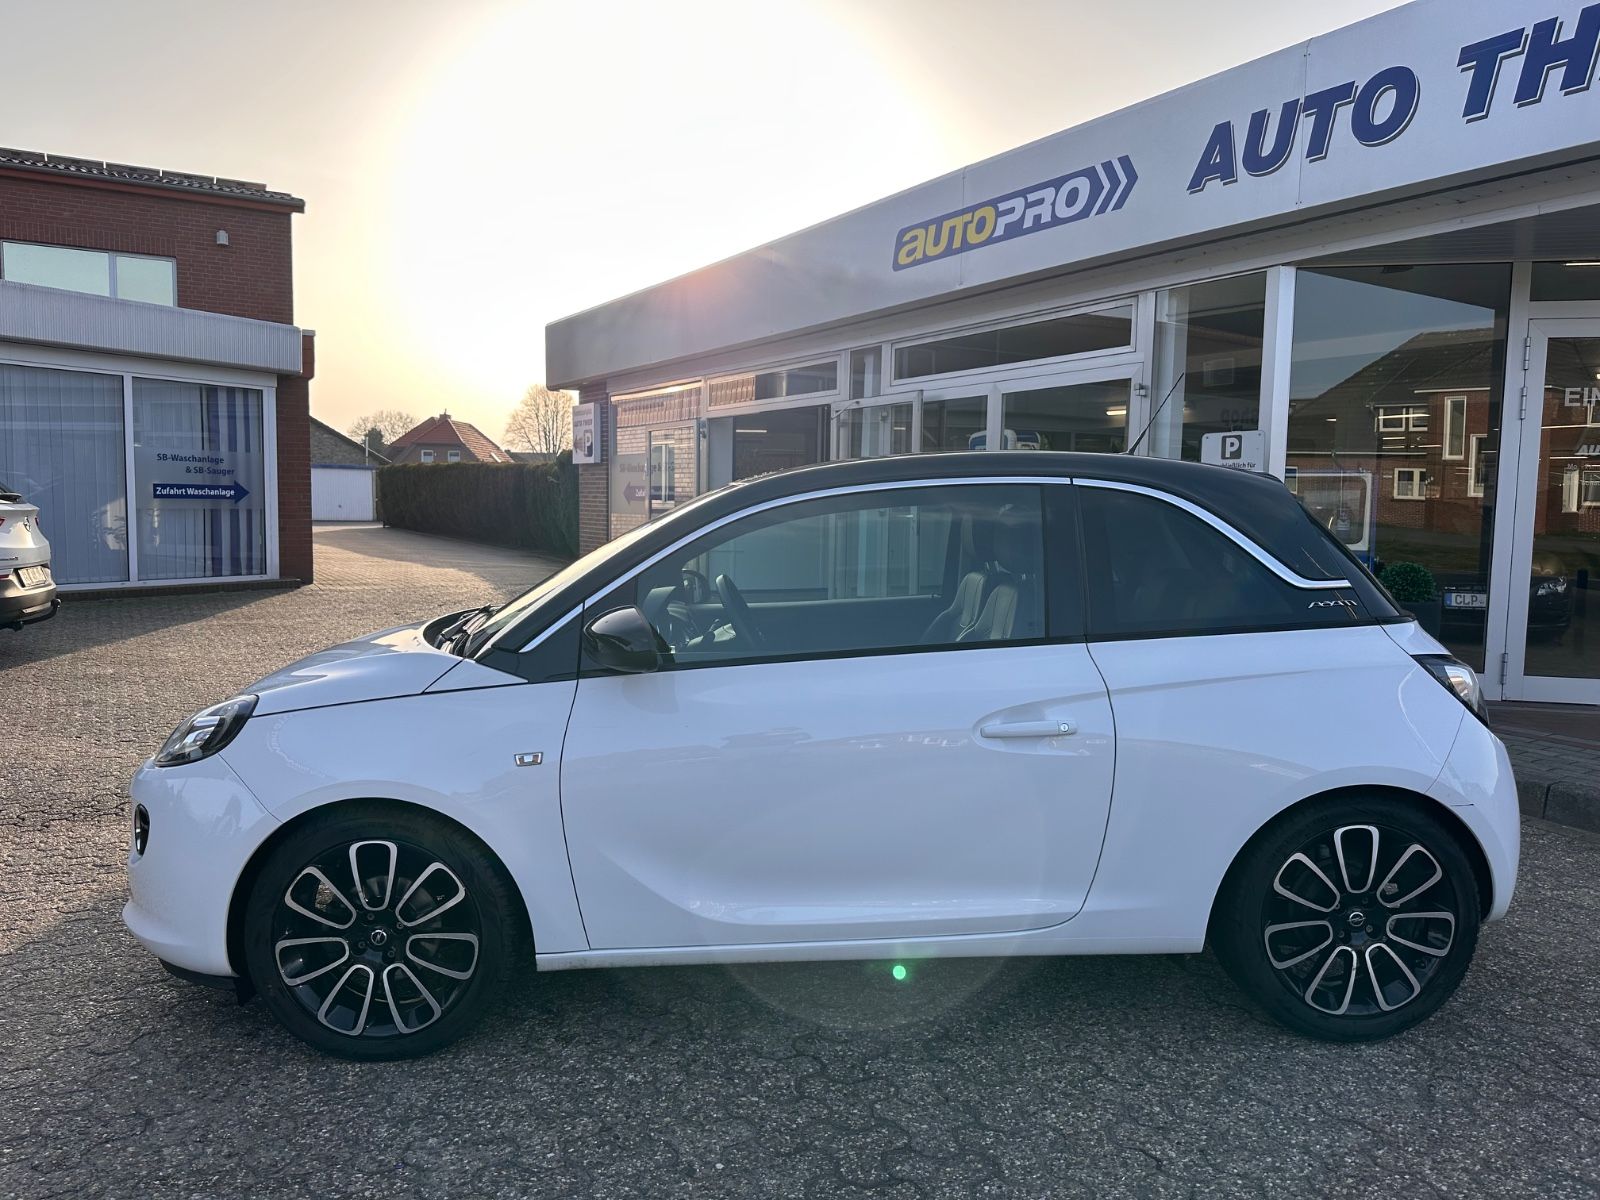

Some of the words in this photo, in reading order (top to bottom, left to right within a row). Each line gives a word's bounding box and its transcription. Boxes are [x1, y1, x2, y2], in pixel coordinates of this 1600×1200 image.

[1186, 65, 1421, 194] AUTO
[1225, 437, 1240, 458] P
[156, 453, 225, 465] SB-Waschanlage
[185, 466, 192, 474] &
[193, 466, 235, 476] SB-Sauger
[156, 487, 186, 495] Zufahrt
[186, 488, 235, 497] Waschanlage
